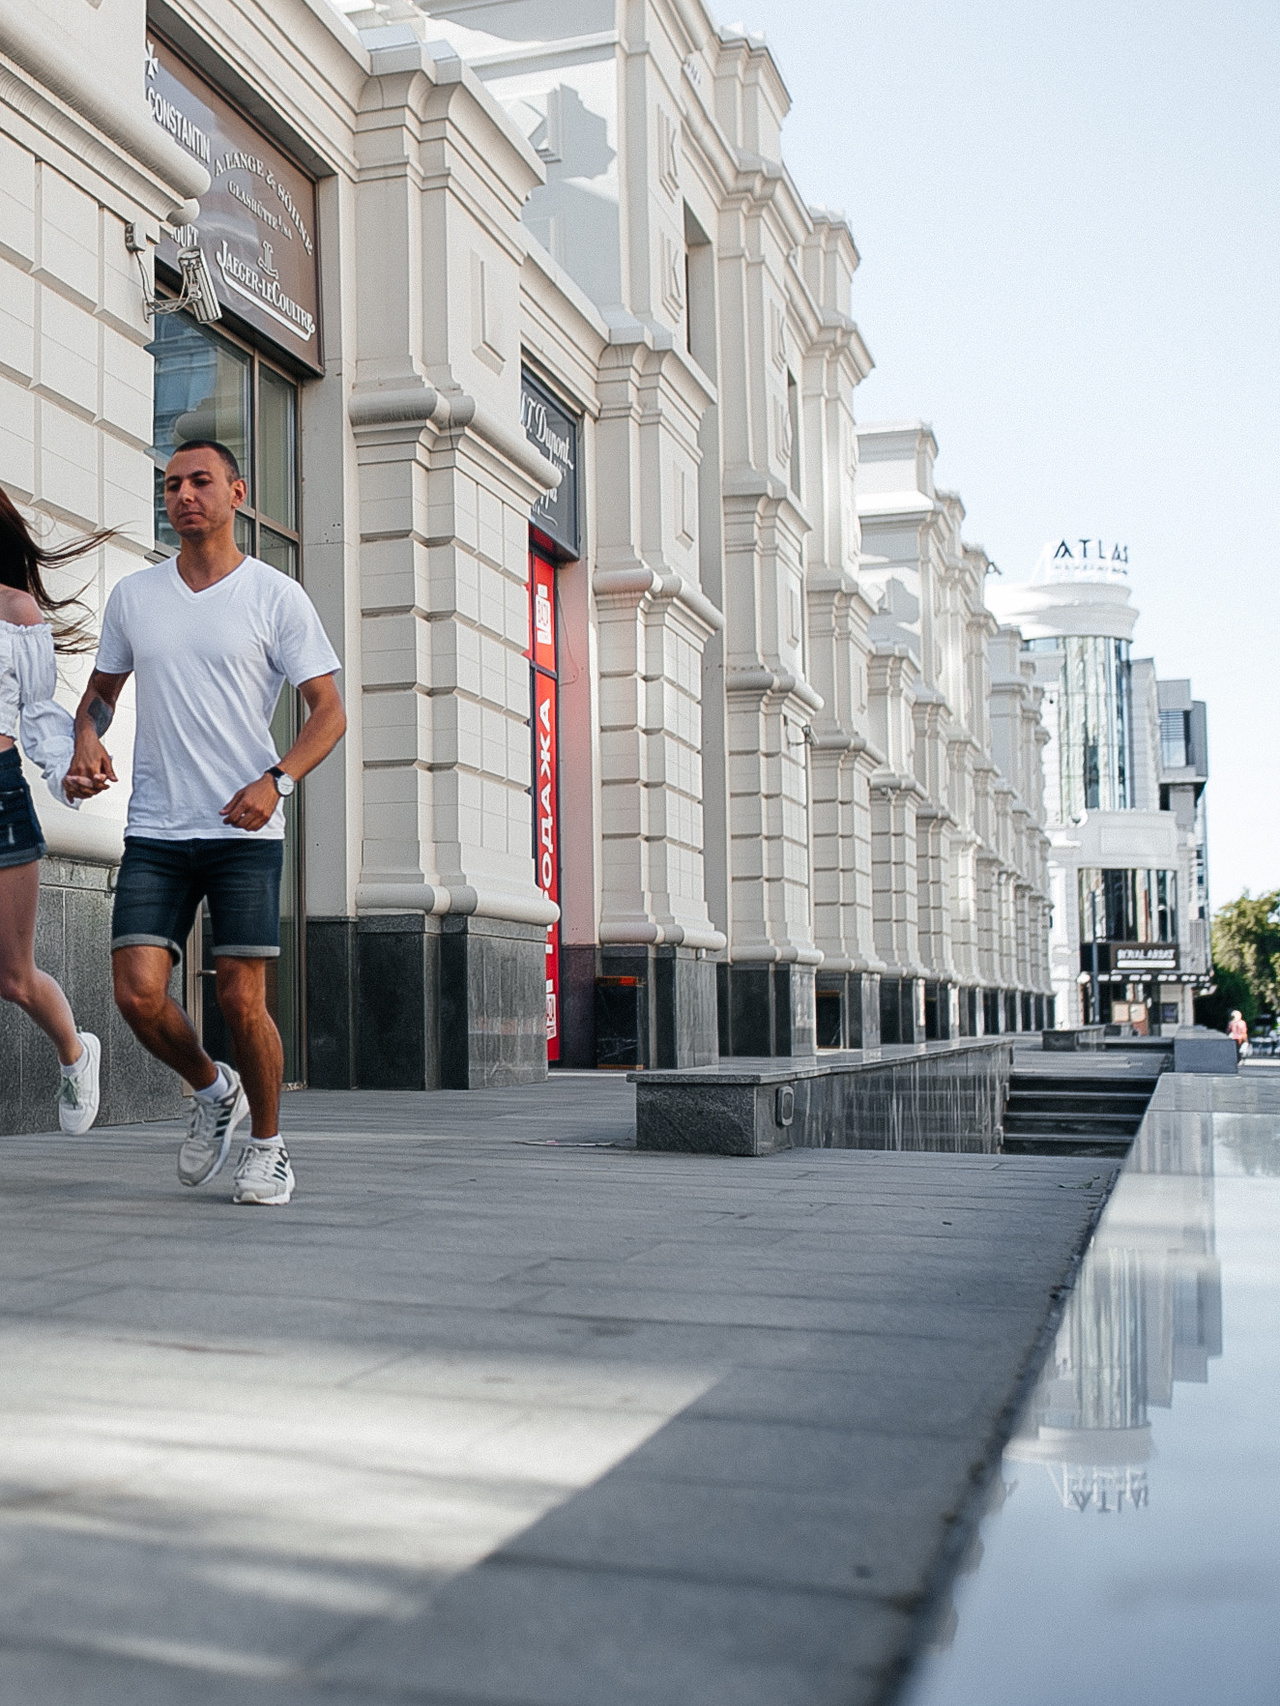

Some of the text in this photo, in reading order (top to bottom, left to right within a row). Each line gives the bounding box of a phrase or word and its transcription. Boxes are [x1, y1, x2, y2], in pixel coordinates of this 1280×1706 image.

[147, 86, 211, 164] CONSTANTIN
[224, 152, 265, 177] LANGE
[535, 403, 574, 470] Dupont
